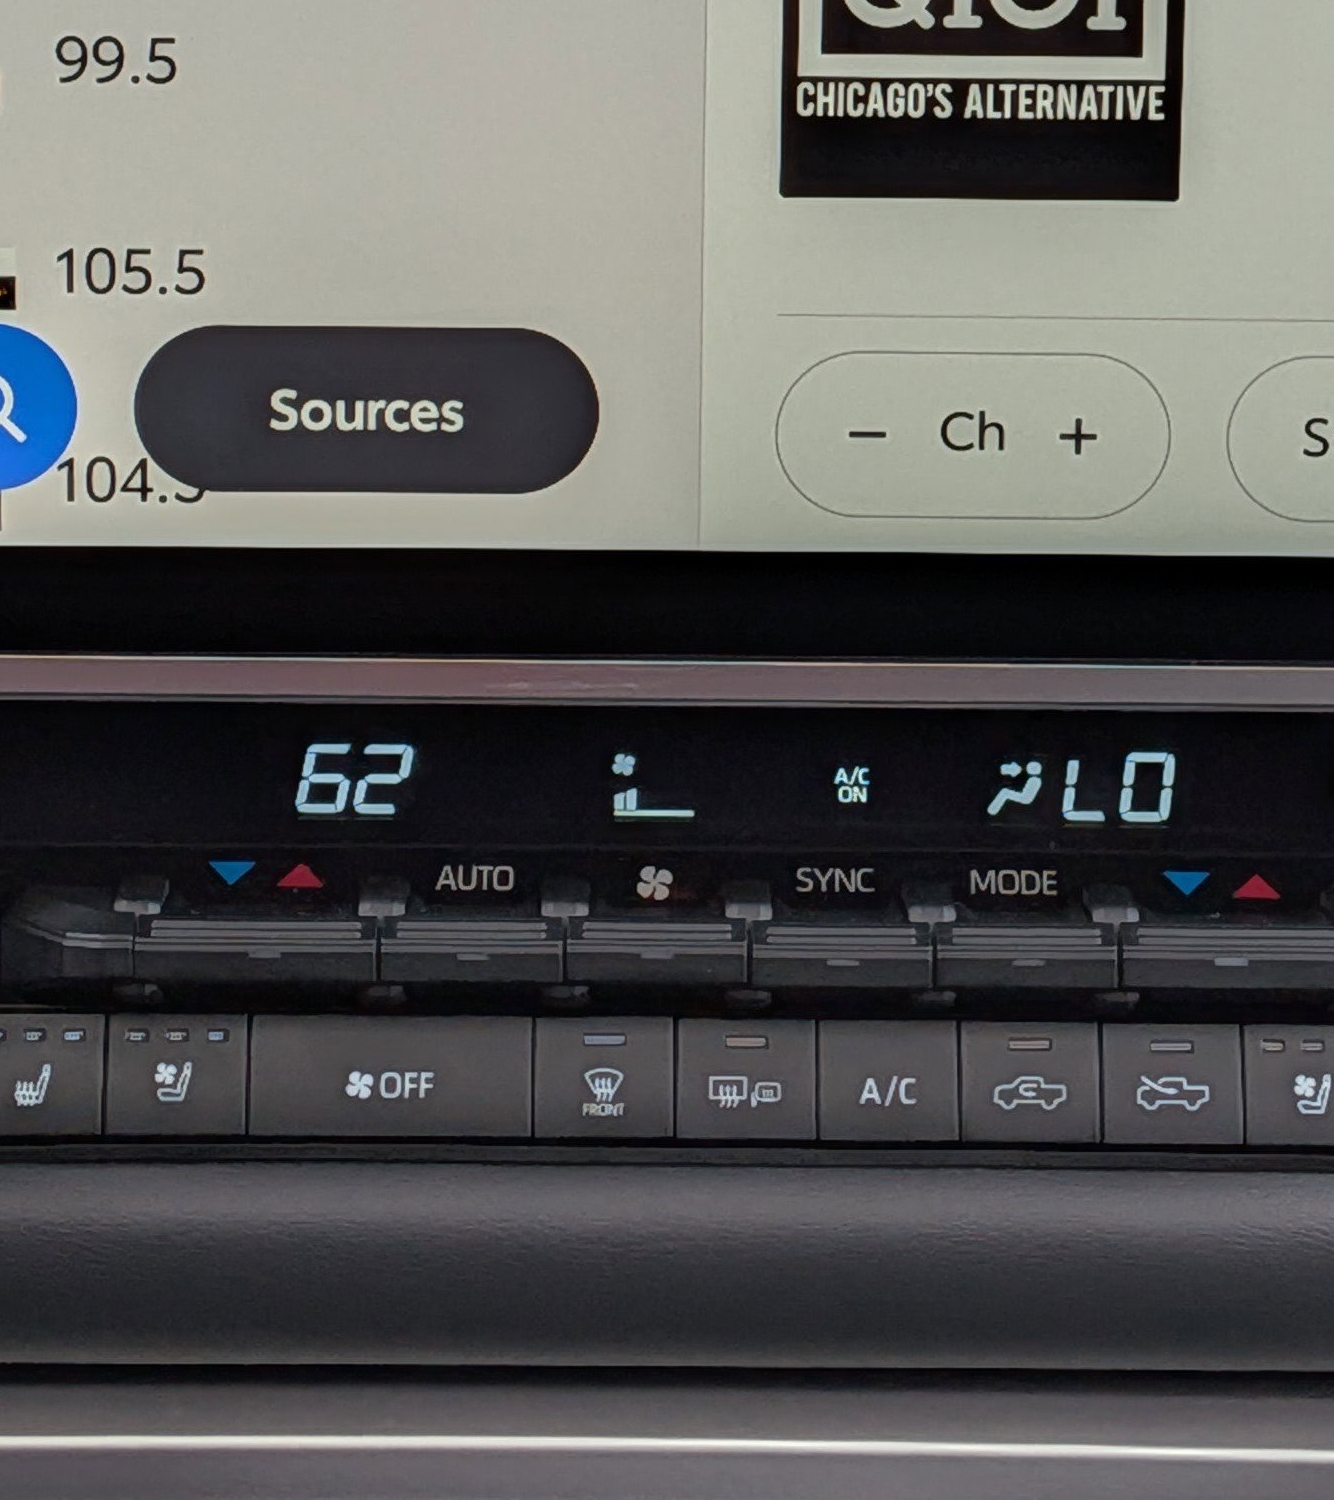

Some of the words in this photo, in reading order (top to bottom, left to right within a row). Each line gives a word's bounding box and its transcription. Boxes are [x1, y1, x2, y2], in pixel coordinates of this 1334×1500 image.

[54, 35, 179, 86] 99.5
[795, 80, 954, 120] CHICAGO'S
[962, 82, 1167, 122] ALTERNATIVE
[55, 247, 207, 296] 105.5
[268, 388, 466, 434] Sources
[939, 410, 1007, 453] Ch
[294, 743, 416, 815] 62
[833, 765, 870, 785] A/C
[837, 785, 868, 803] ON
[435, 865, 516, 893] AUTO
[795, 867, 876, 894] SYNC
[970, 868, 1059, 896] MODE
[379, 1073, 435, 1100] OFF
[859, 1076, 918, 1106] A/C
